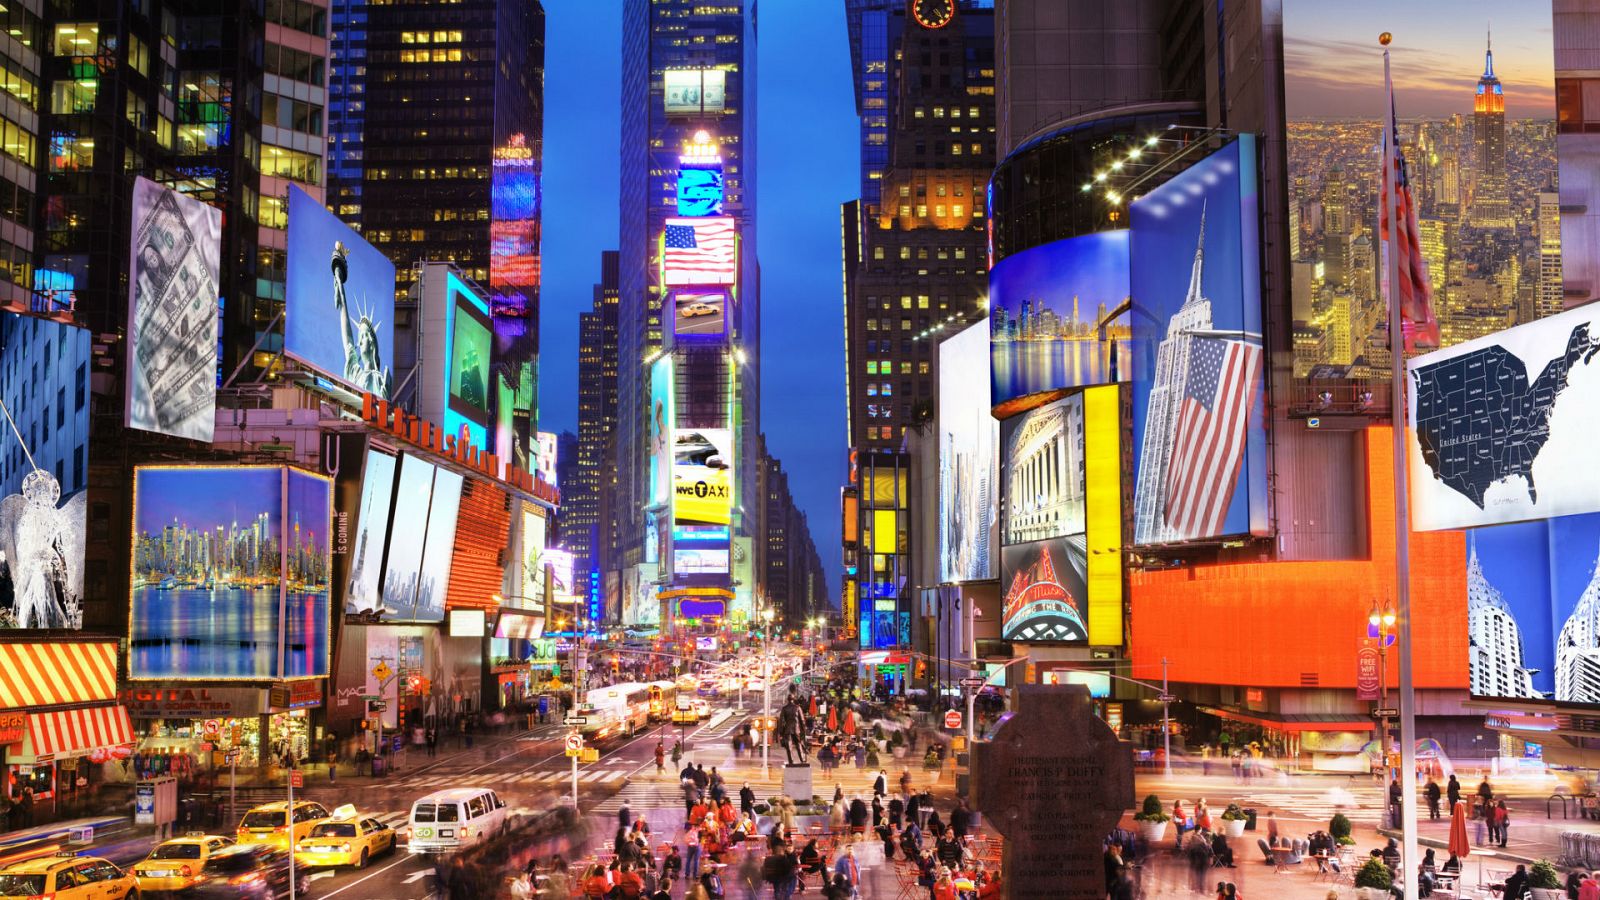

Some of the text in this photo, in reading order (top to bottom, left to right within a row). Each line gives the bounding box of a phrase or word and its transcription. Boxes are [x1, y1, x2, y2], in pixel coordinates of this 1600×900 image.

[1440, 432, 1482, 447] United States
[676, 486, 694, 495] NYC
[338, 511, 348, 554] IS COMING
[1042, 603, 1056, 611] THE
[1360, 658, 1376, 666] FREE
[1008, 767, 1053, 777] FRANCIS
[1067, 766, 1105, 777] DUFFY
[417, 828, 431, 837] GO
